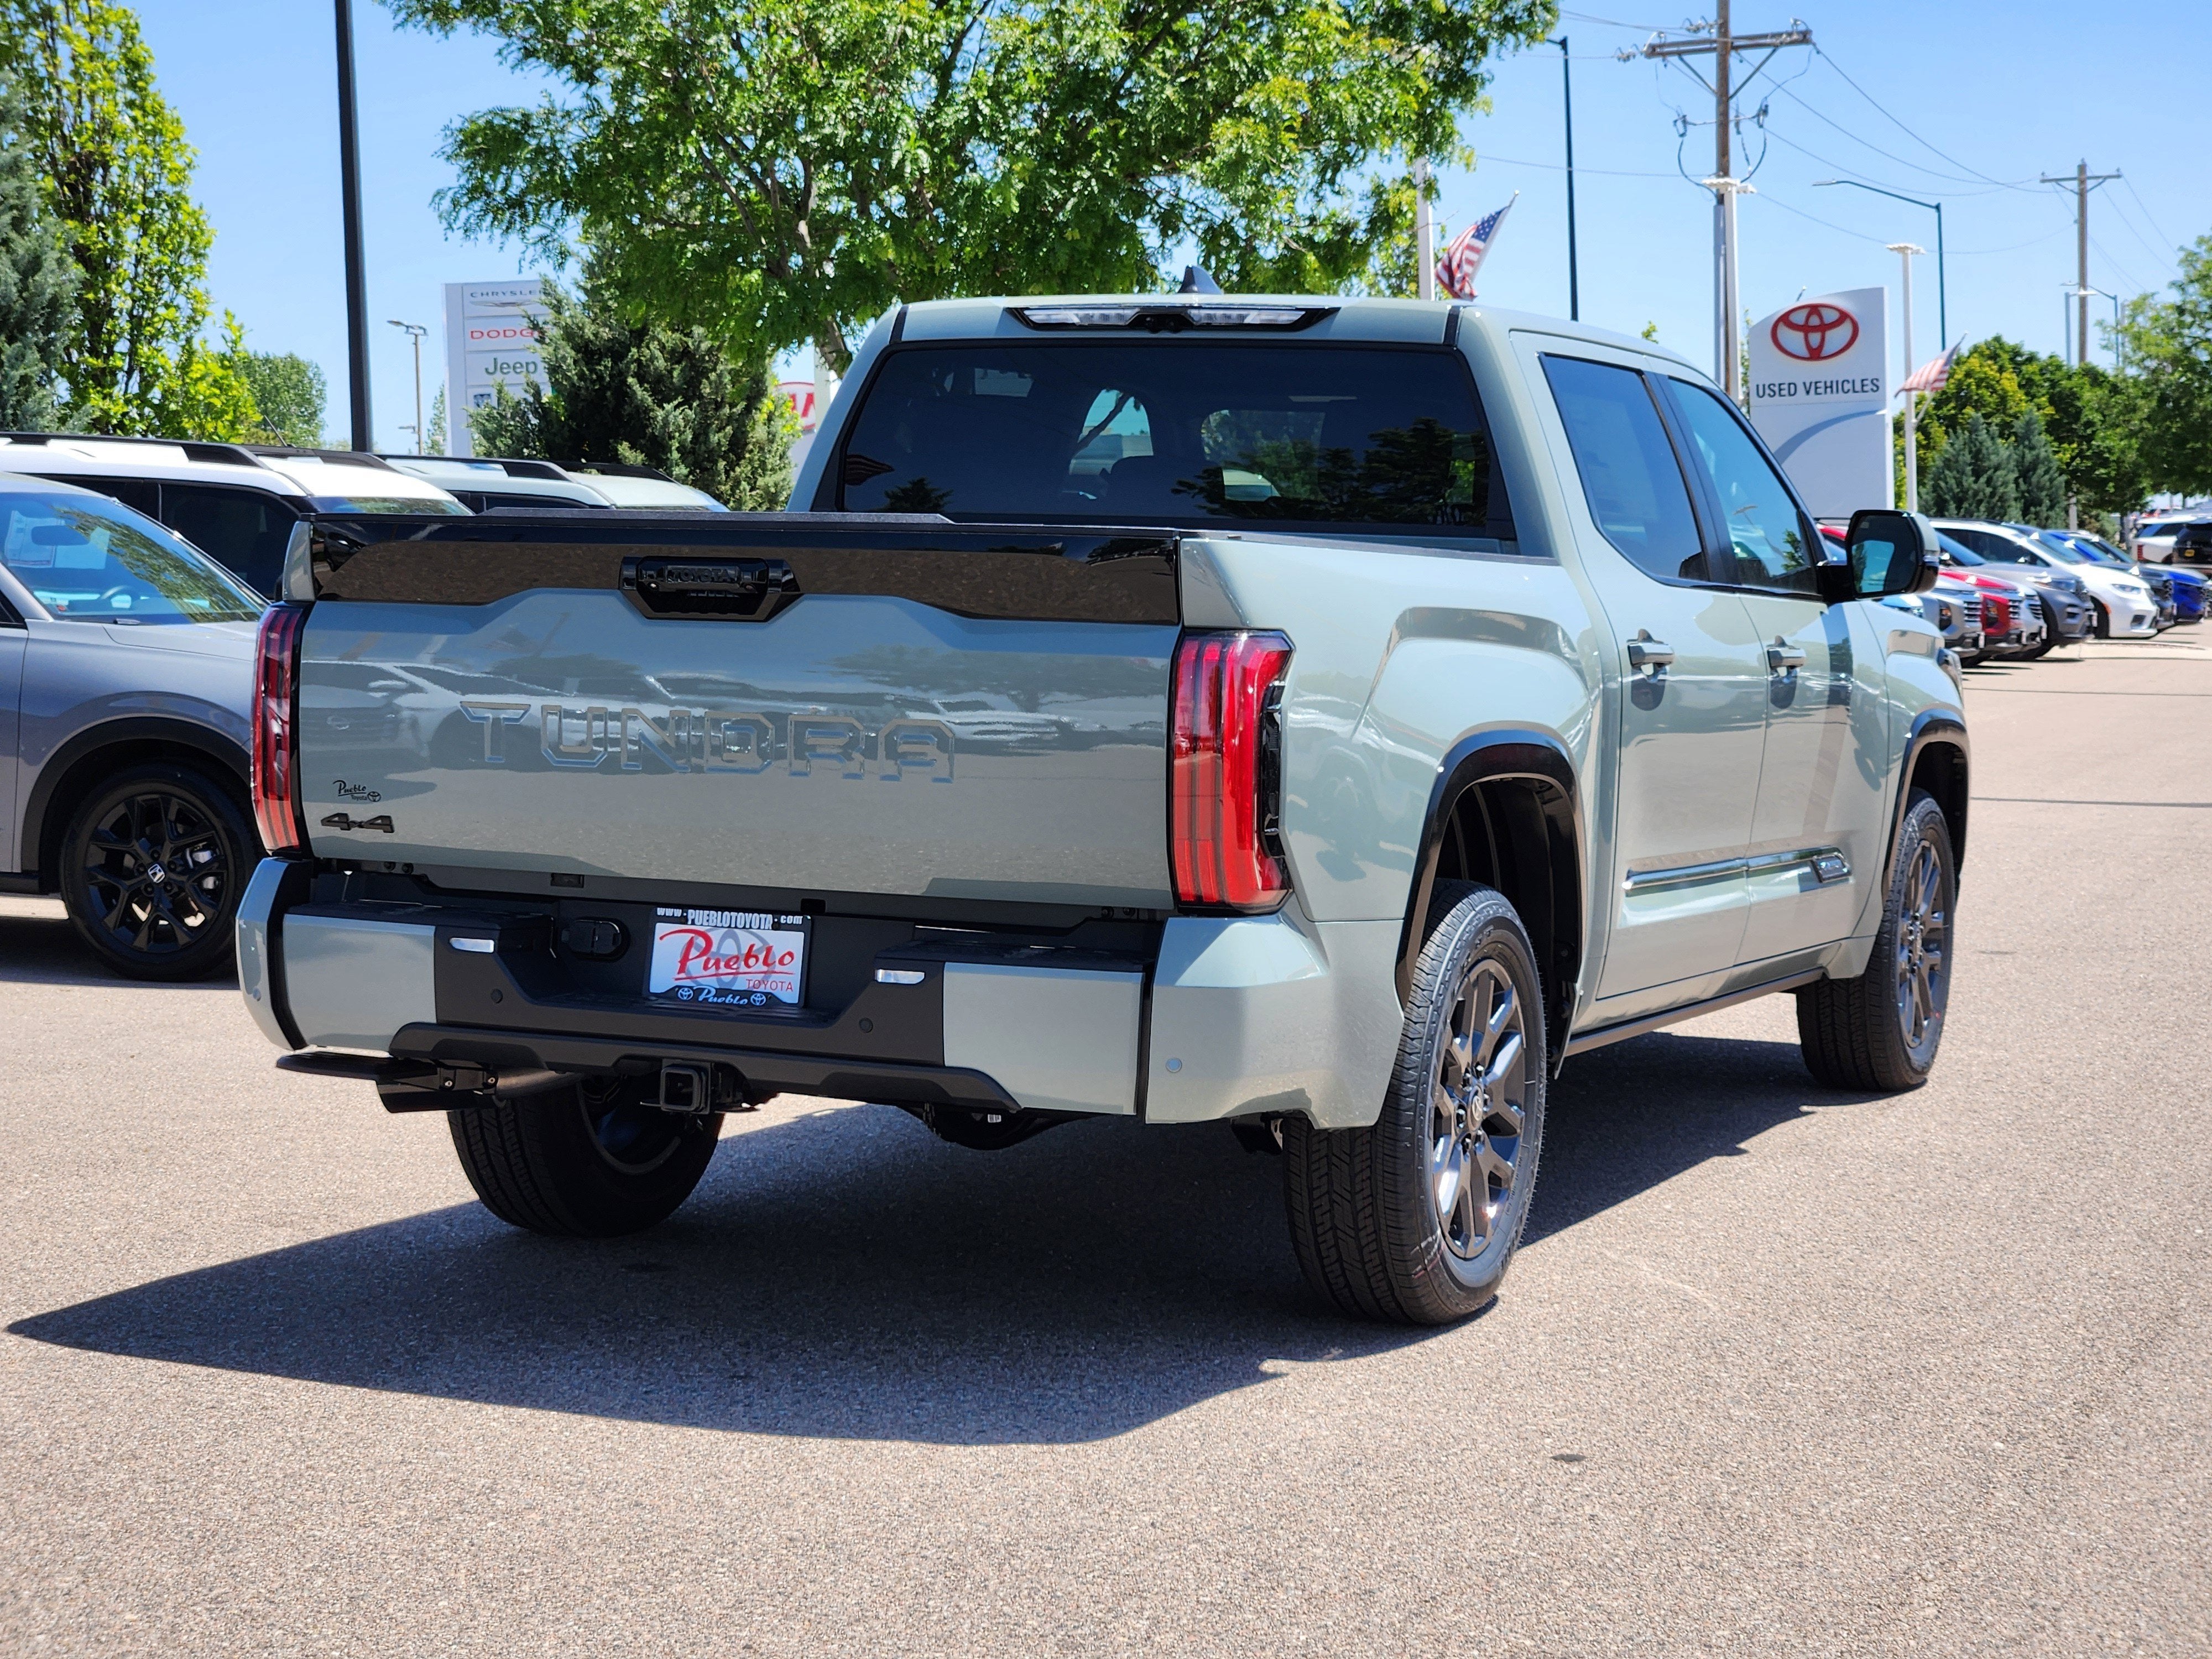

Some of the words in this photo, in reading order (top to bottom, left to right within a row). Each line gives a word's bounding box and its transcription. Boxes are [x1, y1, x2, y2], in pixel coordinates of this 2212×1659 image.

[470, 289, 543, 298] CHRYSLE
[471, 328, 541, 340] DODG
[484, 357, 538, 376] Jeep
[1756, 382, 1797, 399] USED
[1803, 377, 1880, 397] VEHICLES
[458, 700, 956, 784] TUNDRA
[332, 780, 367, 795] Pueblo
[320, 812, 395, 834] 4x4
[659, 928, 795, 975] Pueblo
[693, 985, 748, 1005] Pueblo
[745, 978, 794, 993] TOYOTA
